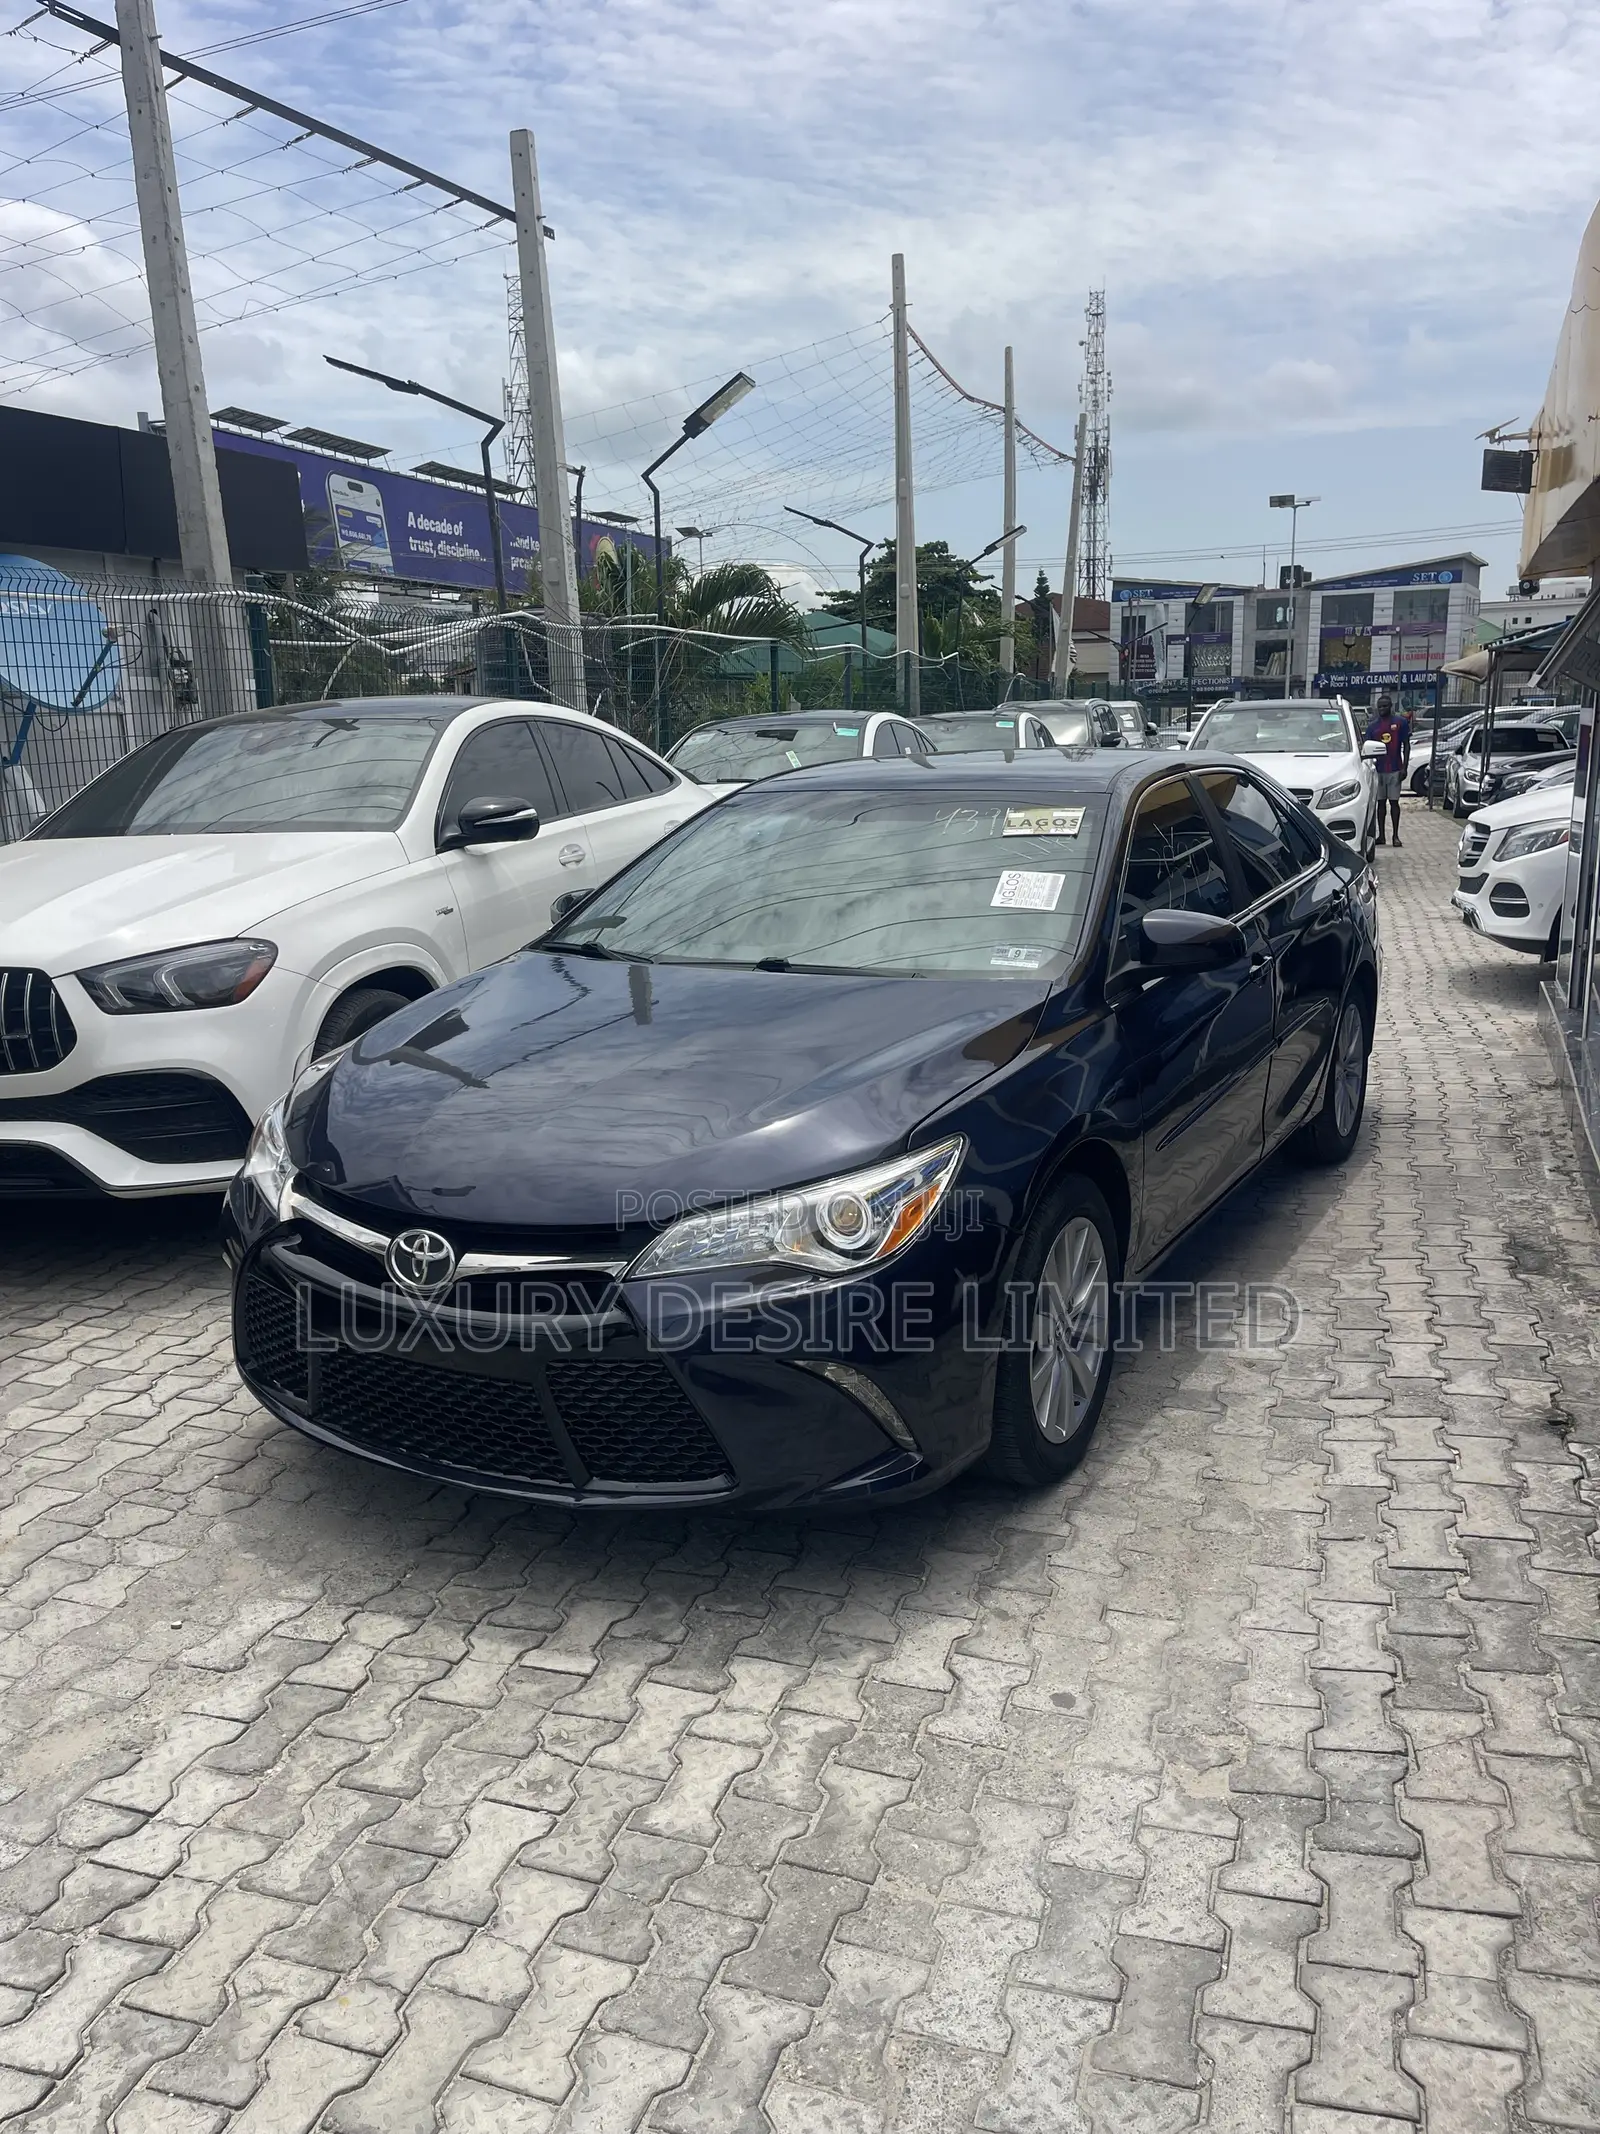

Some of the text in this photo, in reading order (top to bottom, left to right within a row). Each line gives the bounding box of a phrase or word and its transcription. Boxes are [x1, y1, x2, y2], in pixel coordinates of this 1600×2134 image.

[408, 511, 463, 536] A decade of
[409, 536, 437, 558] trust,
[1412, 571, 1437, 581] SET
[1132, 588, 1153, 598] SET
[1351, 674, 1399, 685] DRY-CLEANING
[1402, 674, 1408, 683] &
[1007, 818, 1079, 828] LAGOS
[1000, 872, 1022, 905] NGLOS
